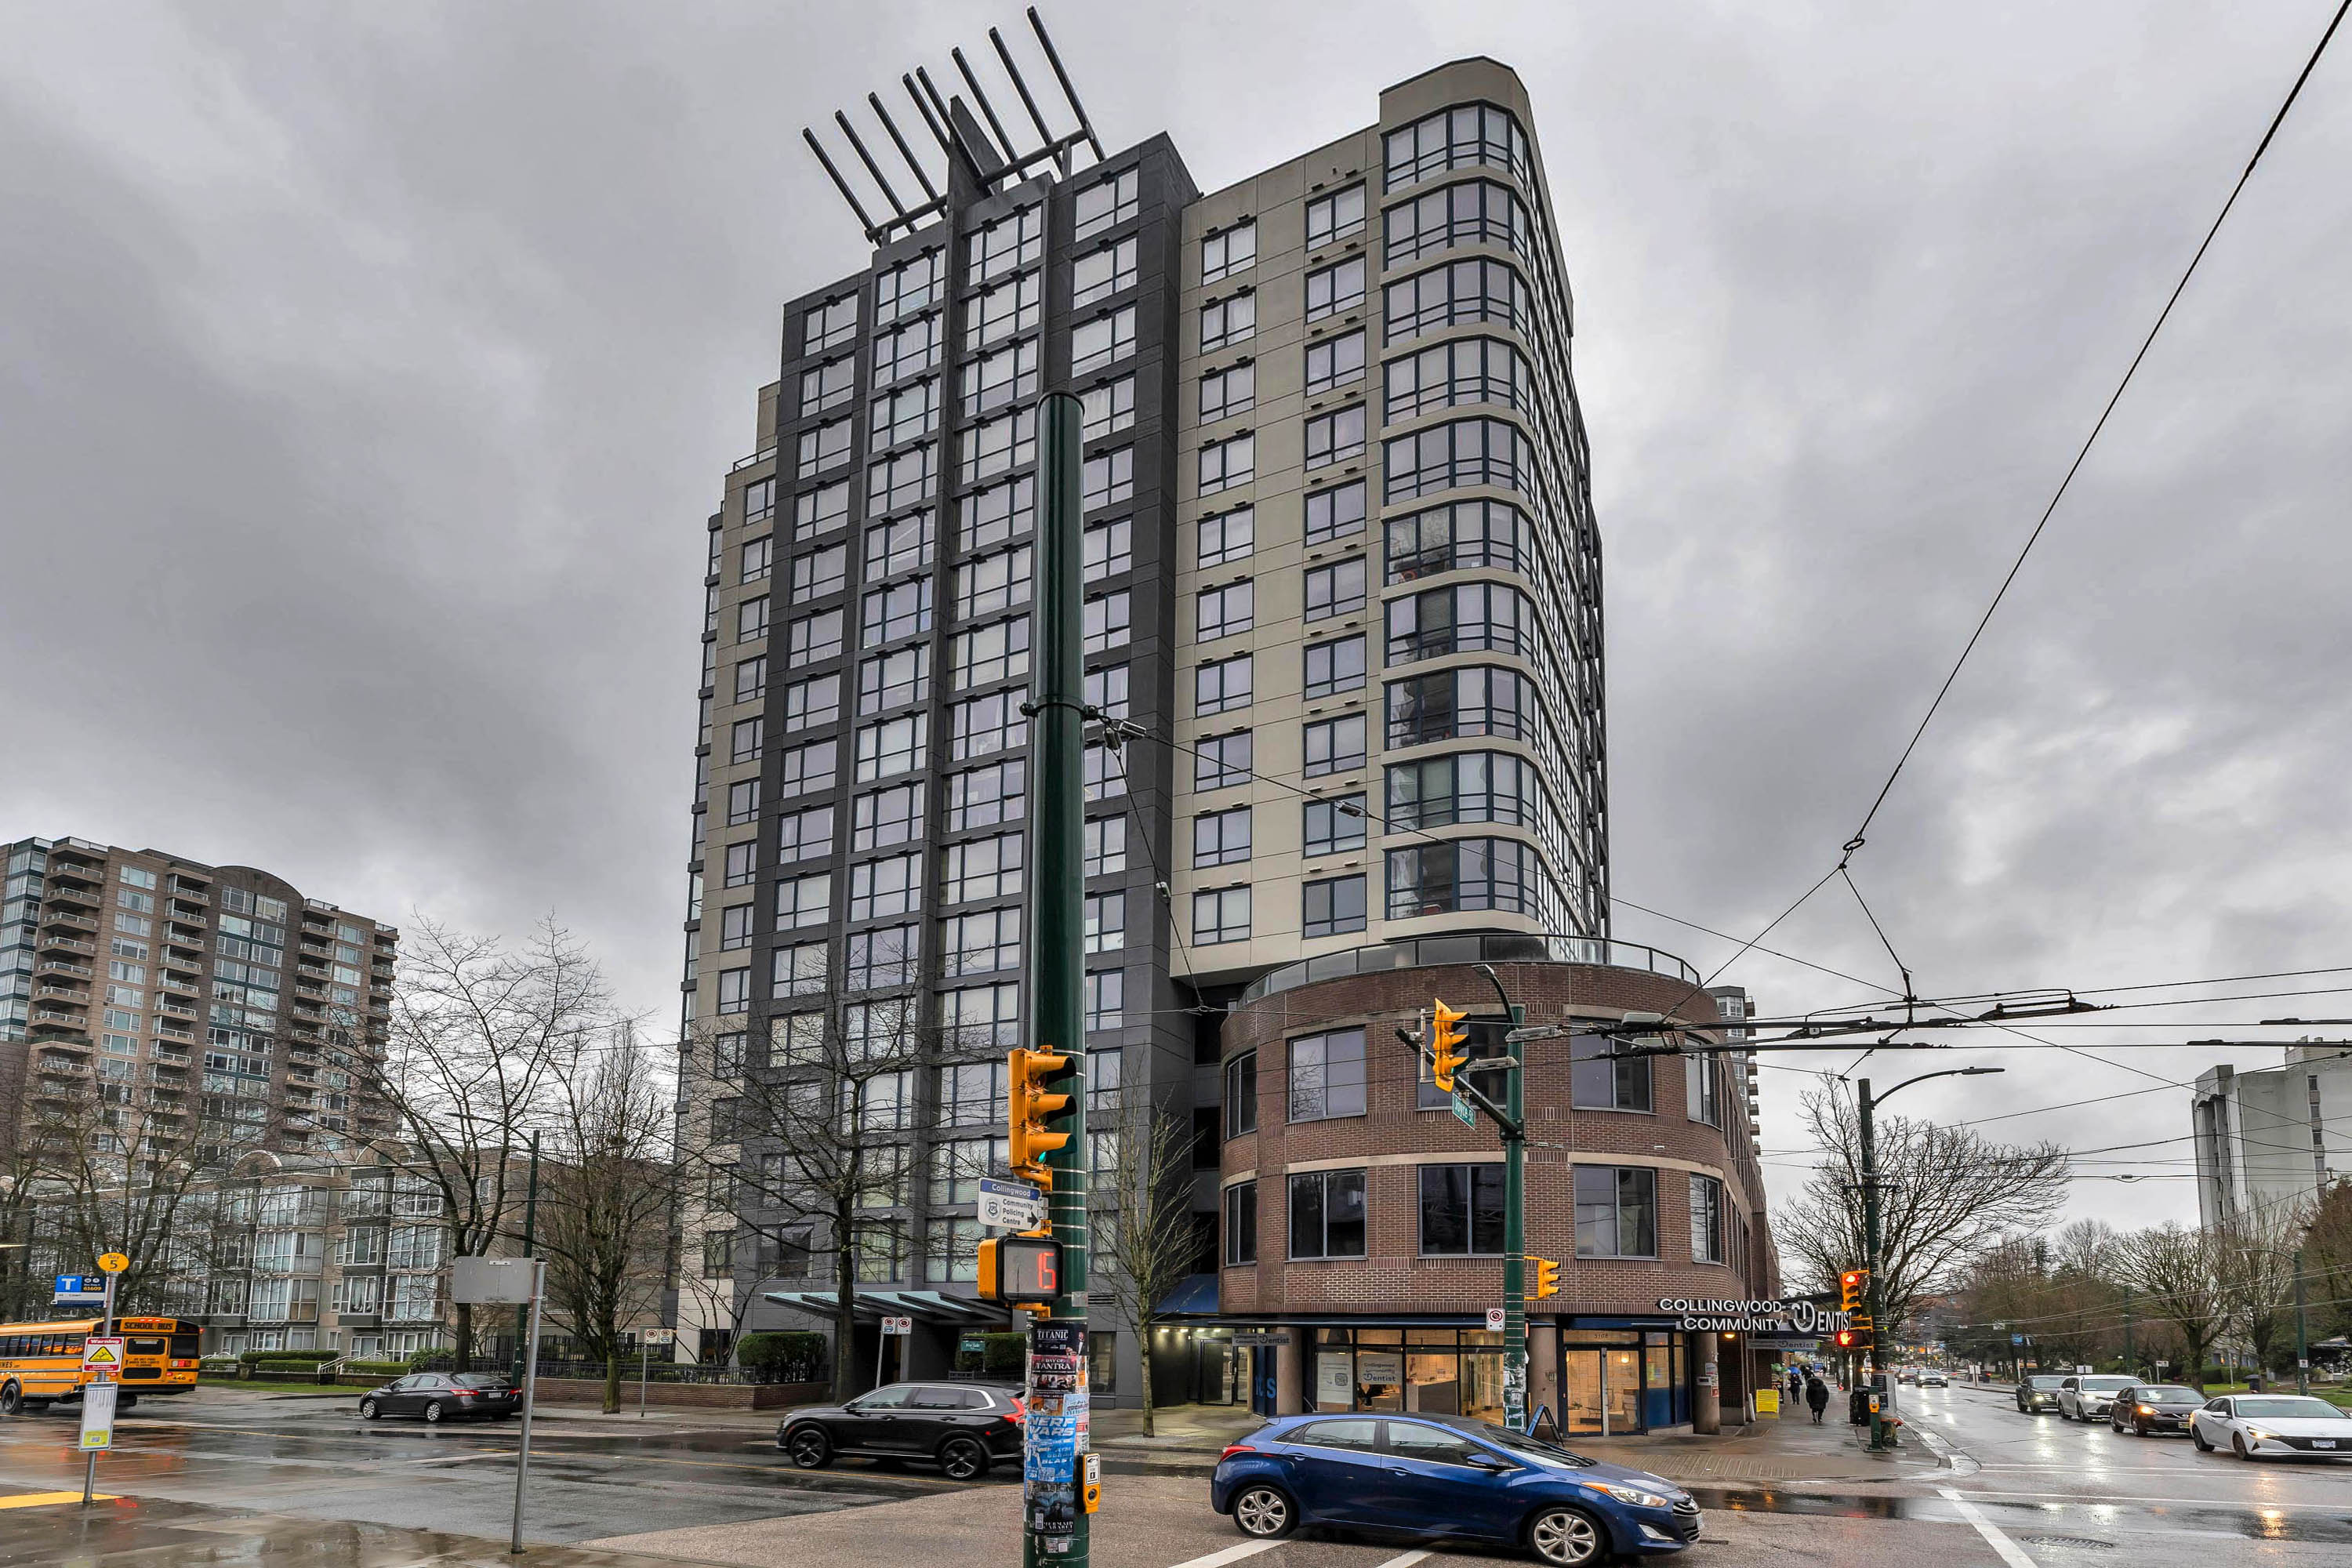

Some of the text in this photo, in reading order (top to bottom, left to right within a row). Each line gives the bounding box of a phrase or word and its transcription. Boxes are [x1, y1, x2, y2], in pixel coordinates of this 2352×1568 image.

[1455, 1098, 1468, 1118] Joyce
[992, 1184, 1031, 1197] Collingwood
[1003, 1199, 1033, 1210] Community
[1003, 1208, 1025, 1218] Policing
[110, 1260, 118, 1269] 5
[61, 1279, 76, 1290] T
[1660, 1298, 1782, 1312] COLLINGWOOD
[1684, 1317, 1782, 1330] COMMUNITY
[1037, 1330, 1069, 1339] TITANIC
[1259, 1334, 1290, 1344] Dentist
[1778, 1340, 1815, 1348] Dentist
[1363, 1373, 1396, 1381] Dentist
[1029, 1417, 1075, 1427] NERF
